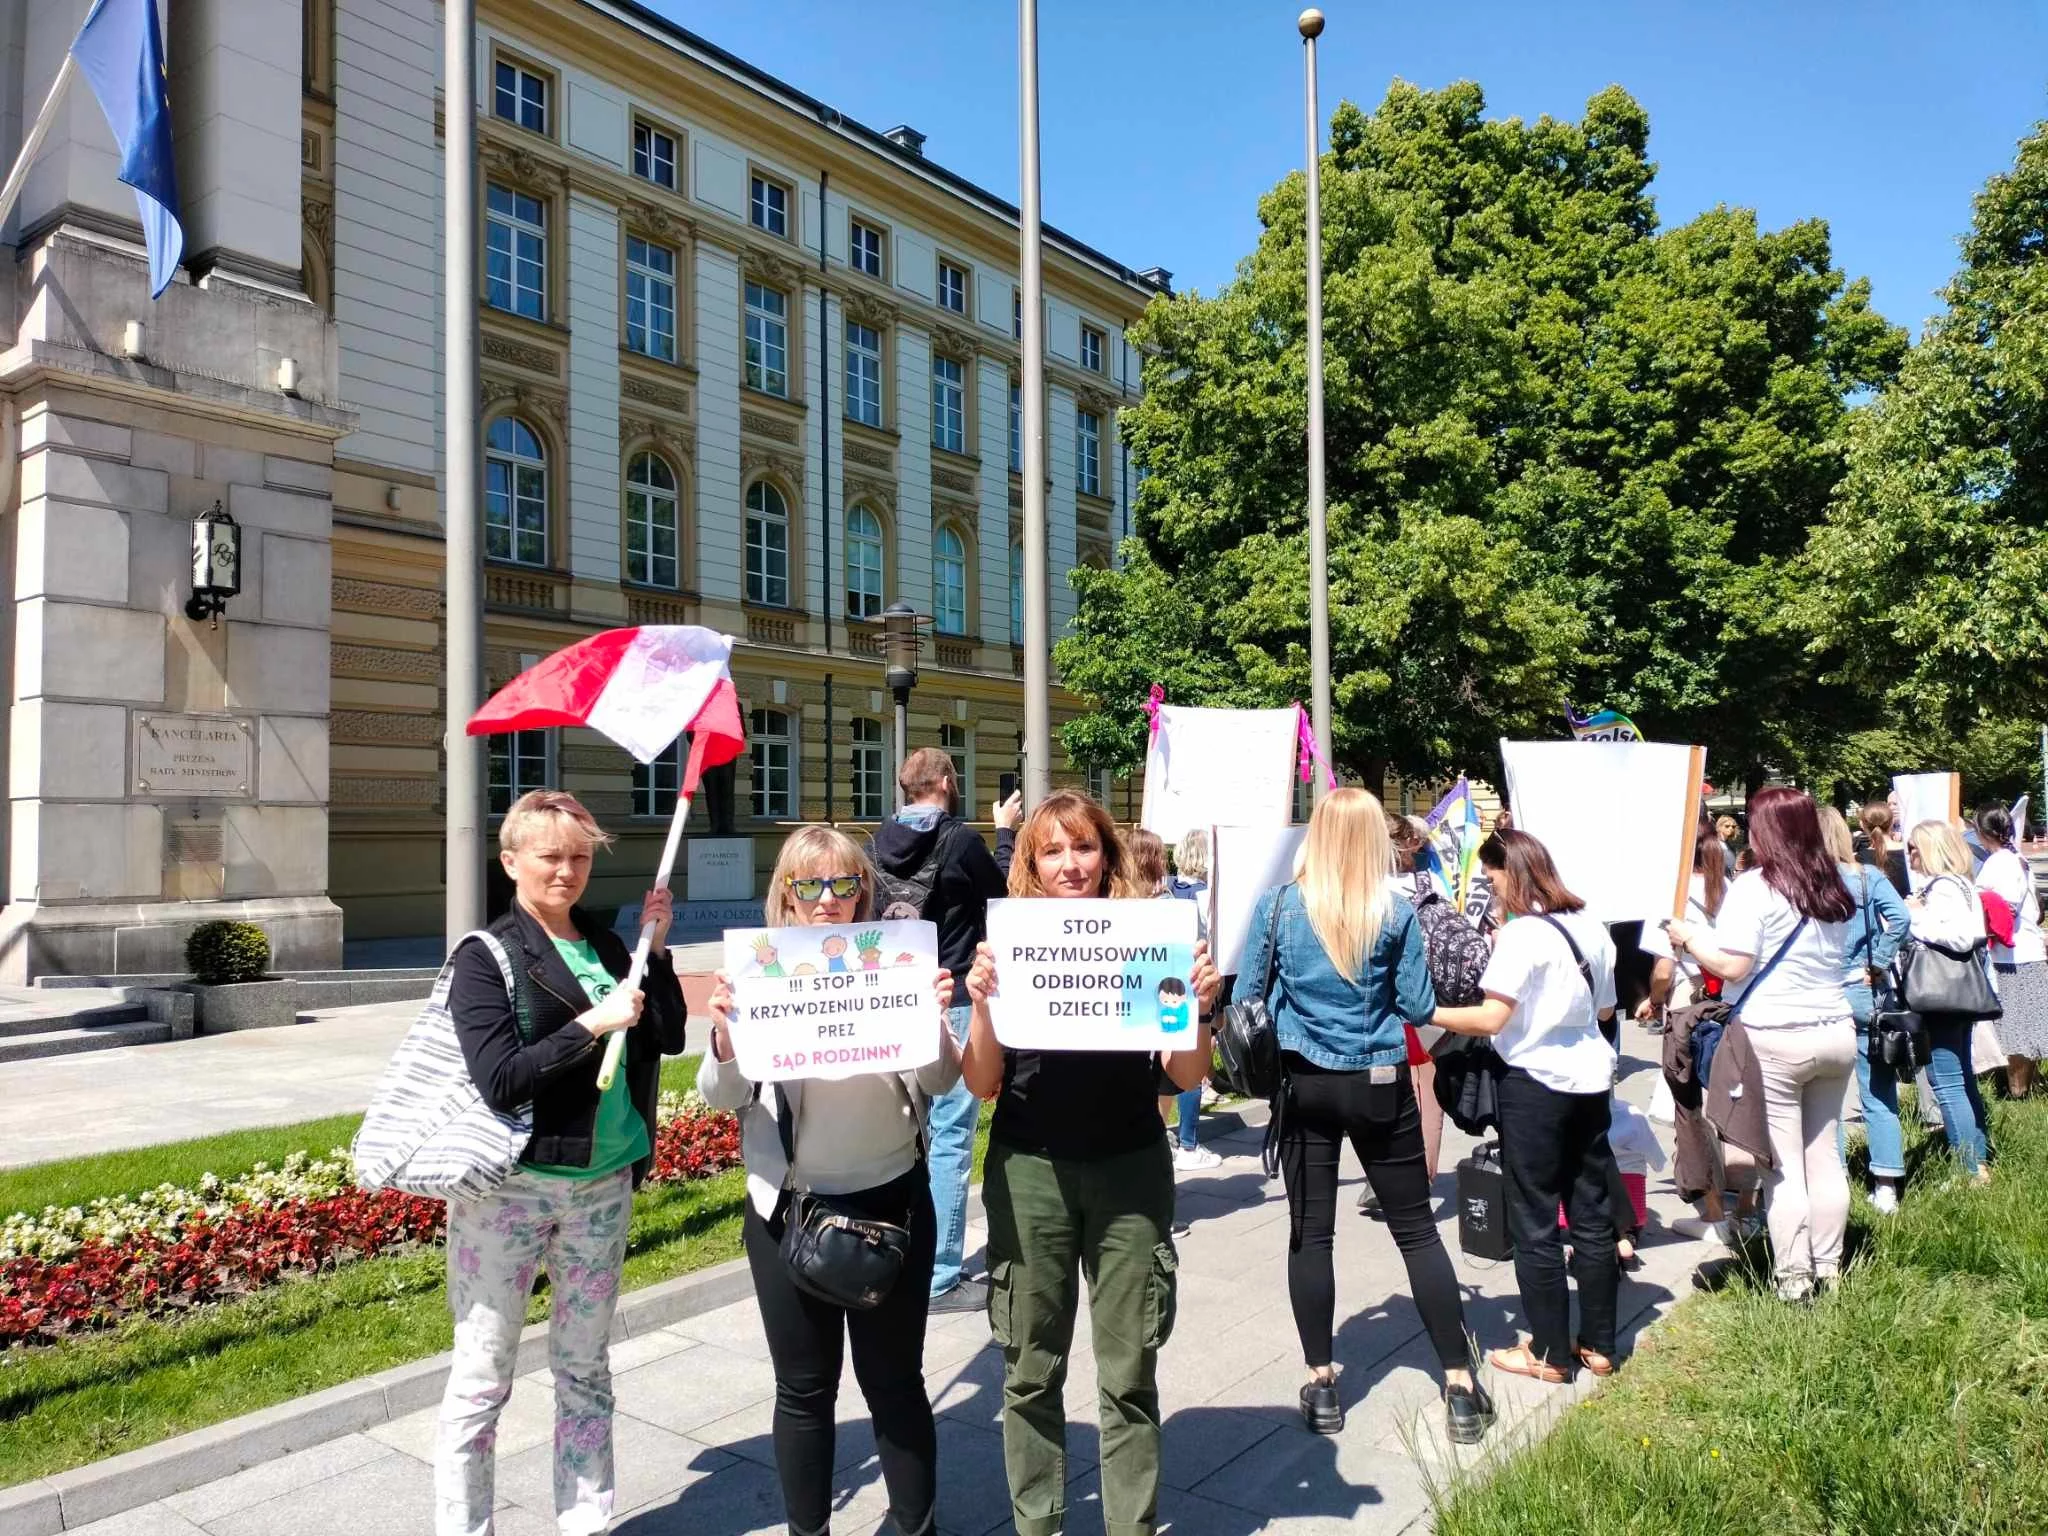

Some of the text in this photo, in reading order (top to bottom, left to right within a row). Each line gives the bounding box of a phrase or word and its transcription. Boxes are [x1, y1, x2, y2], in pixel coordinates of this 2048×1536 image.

[151, 728, 237, 742] KANCELARIA
[173, 752, 216, 762] PREZESA
[150, 767, 176, 776] RADY
[1063, 919, 1112, 935] STOP
[1012, 946, 1168, 962] PRZYMUSOWYM
[789, 973, 879, 993] !!! STOP !!!
[1032, 974, 1143, 990] ODBIOROM
[750, 993, 918, 1021] KRZYWDZENIU DZIECI
[1049, 1001, 1131, 1017] DZIECI !!!
[818, 1022, 856, 1039] PREZ
[772, 1043, 903, 1072] SĄD RODZINNY
